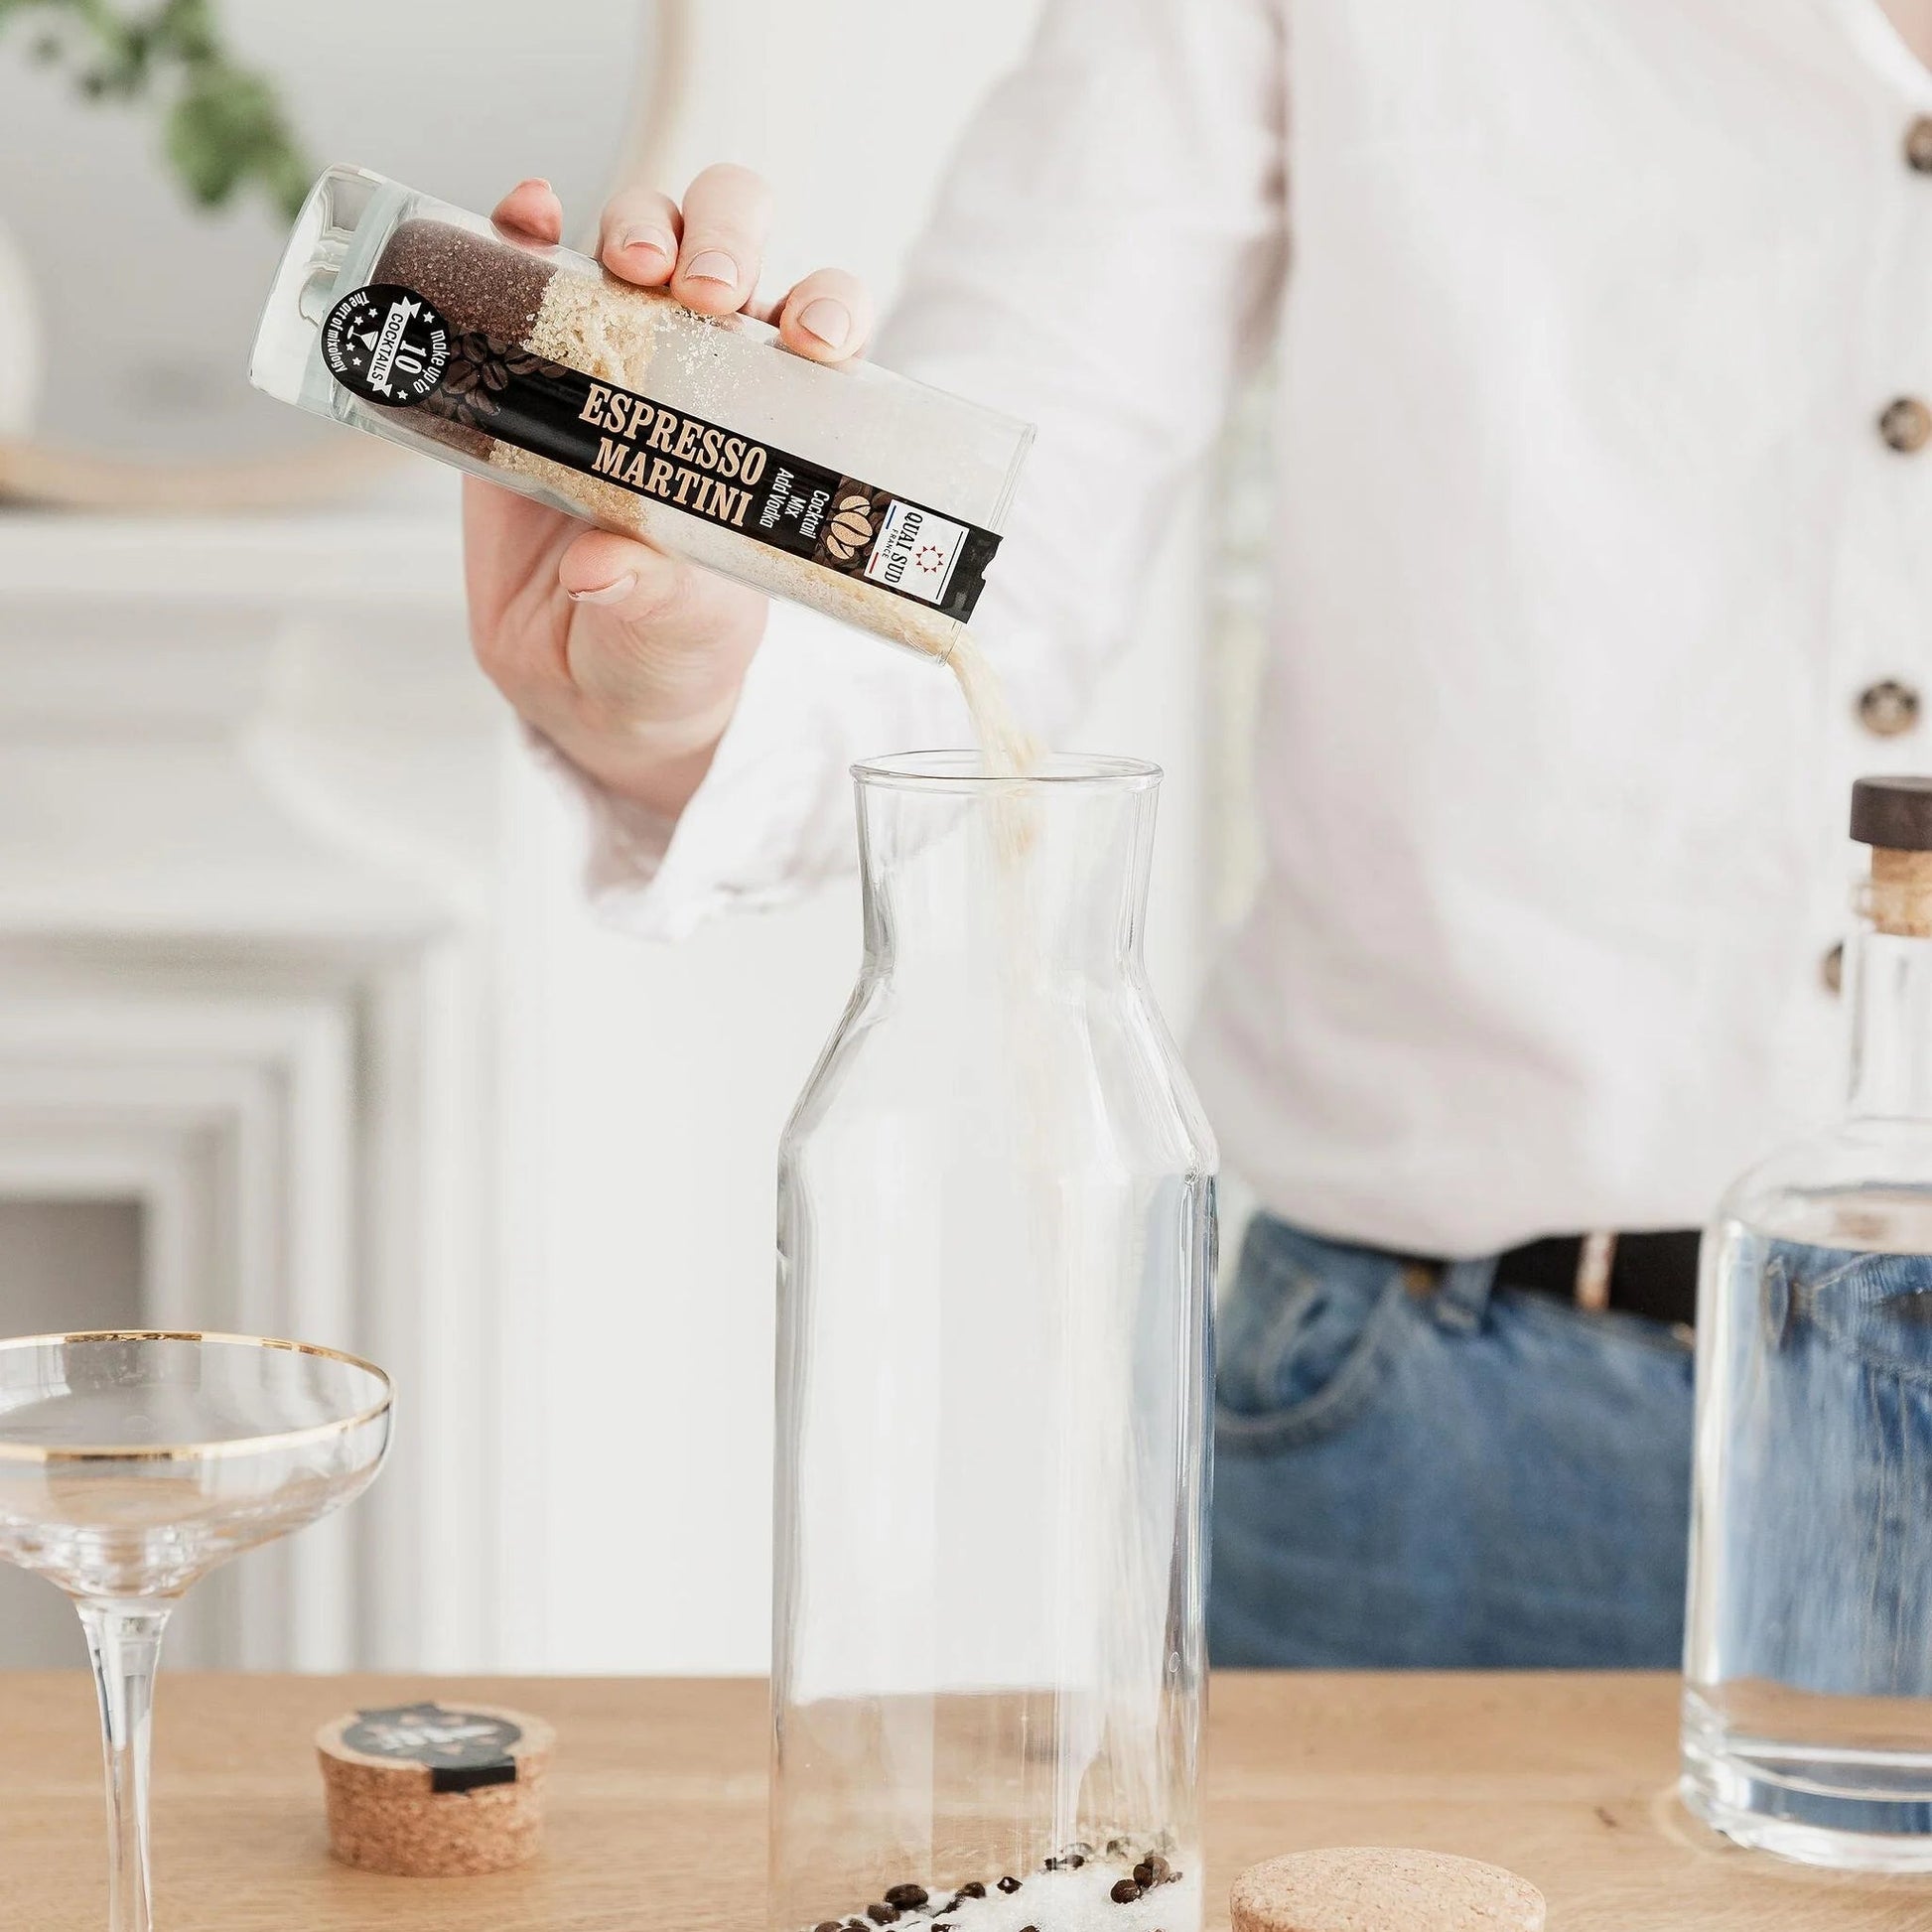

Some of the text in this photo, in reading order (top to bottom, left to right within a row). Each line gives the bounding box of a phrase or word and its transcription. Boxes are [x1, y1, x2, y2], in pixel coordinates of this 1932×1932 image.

[327, 291, 369, 372] The art of mixology
[371, 313, 403, 381] COCKTAILS
[395, 340, 427, 374] 10
[413, 330, 450, 394] make up to
[578, 382, 767, 486] ESPRESSO
[591, 437, 754, 527] MARTINI
[759, 467, 794, 528] Add Vodka
[784, 494, 806, 519] Mix
[798, 489, 830, 539] Cocktail
[881, 528, 897, 559] FRANCE
[884, 511, 923, 584] QUAI SUD
